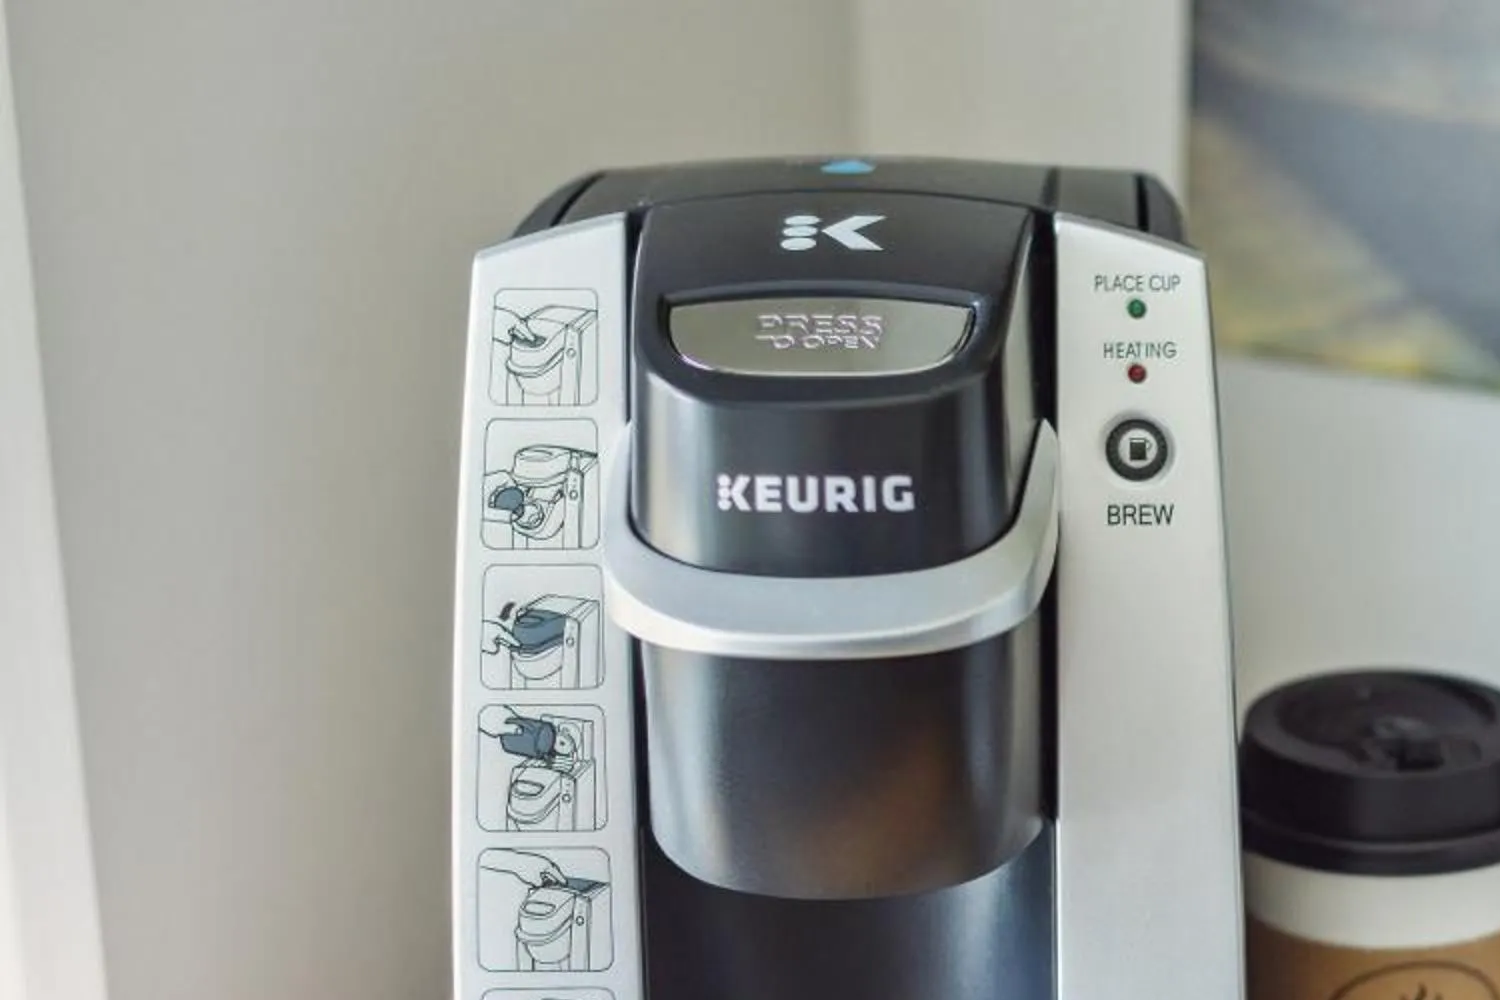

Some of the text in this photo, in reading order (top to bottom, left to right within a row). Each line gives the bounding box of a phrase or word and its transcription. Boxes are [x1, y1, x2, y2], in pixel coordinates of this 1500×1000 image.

[1094, 274, 1181, 292] PLACE CUP
[757, 314, 883, 335] PRESS
[756, 335, 880, 349] TO OPEN
[1103, 341, 1178, 359] HEATING
[717, 474, 915, 513] KEURIG
[1106, 503, 1175, 526] BREW
